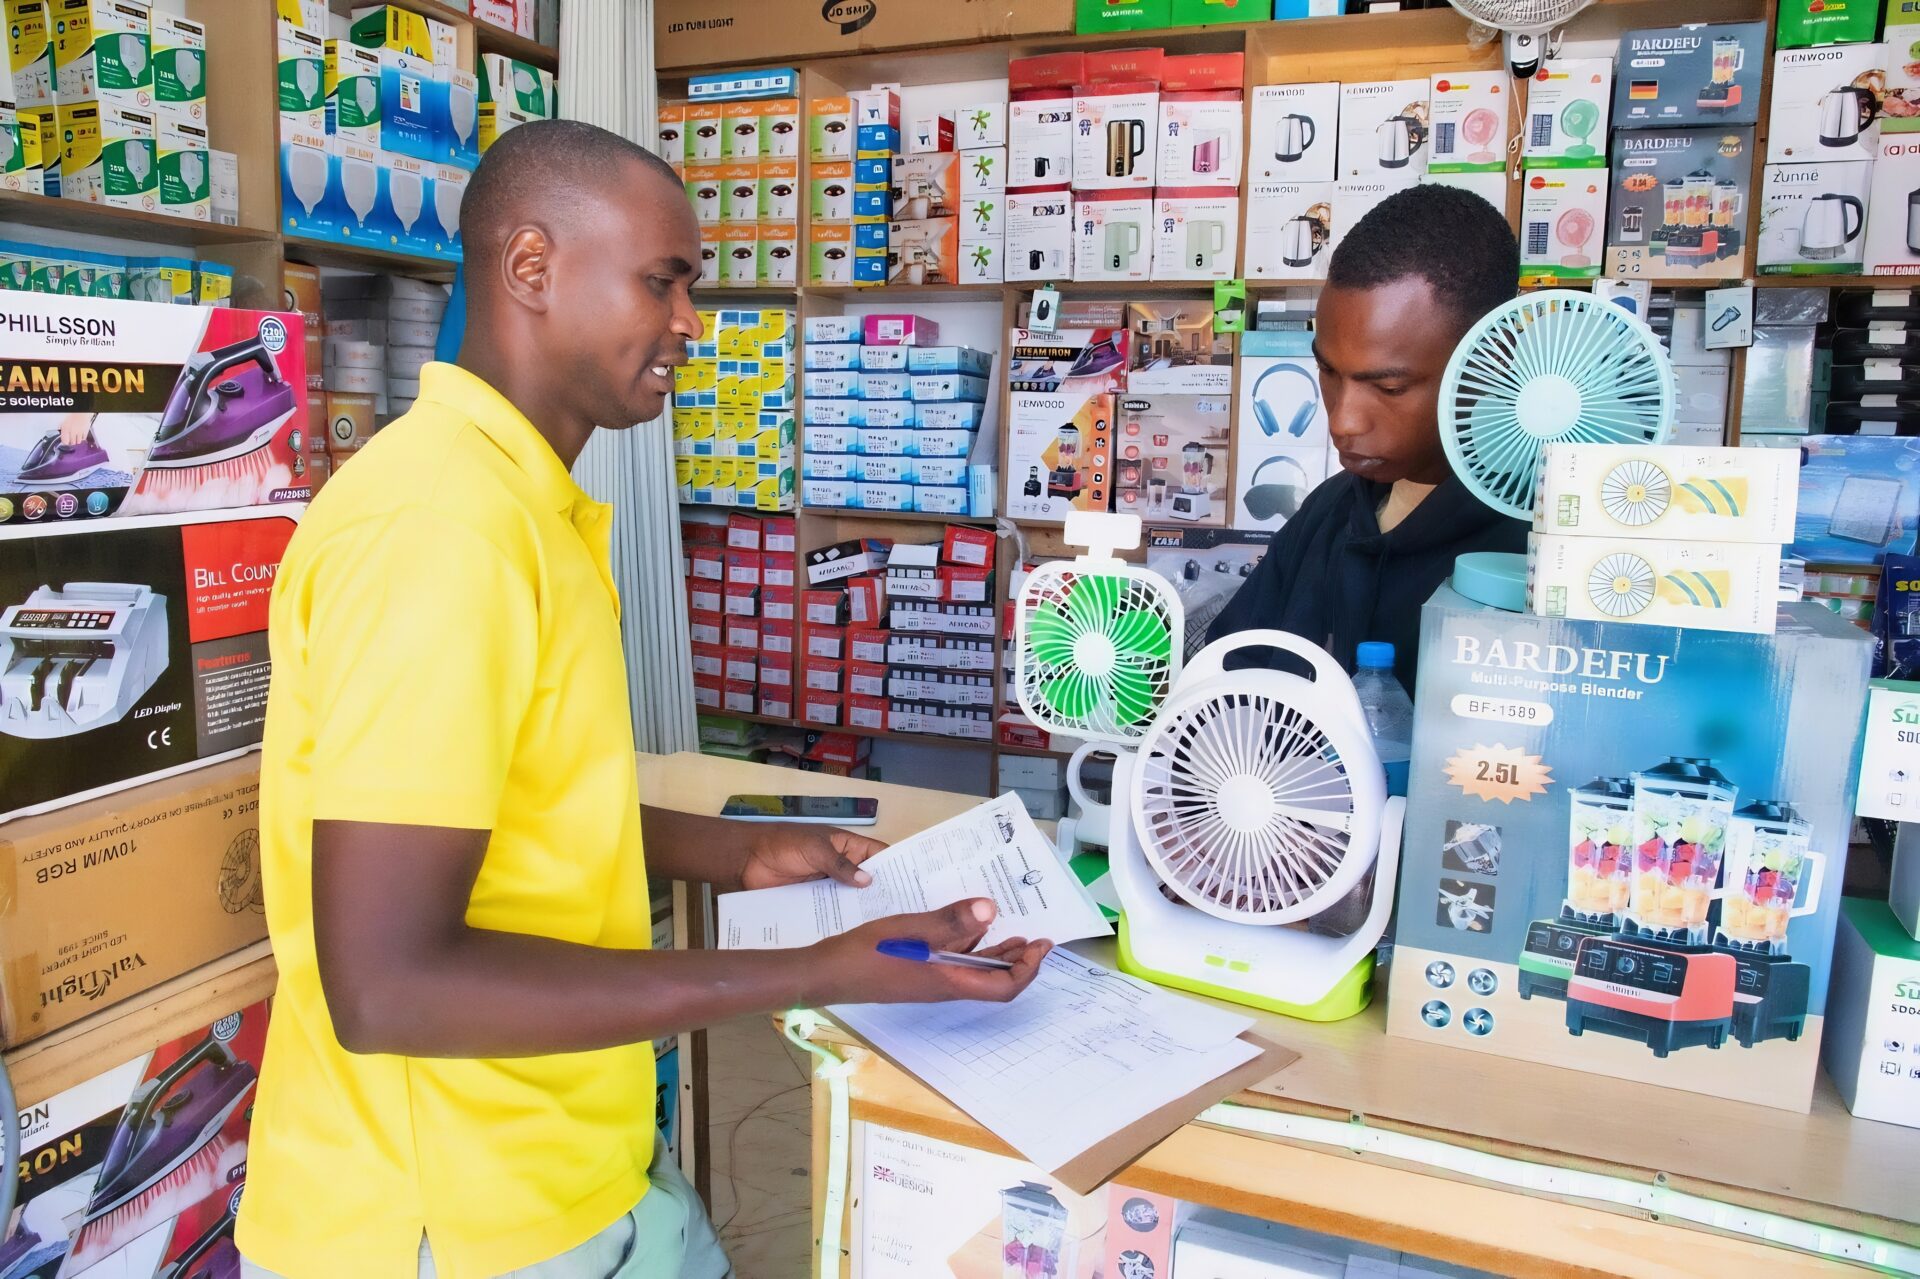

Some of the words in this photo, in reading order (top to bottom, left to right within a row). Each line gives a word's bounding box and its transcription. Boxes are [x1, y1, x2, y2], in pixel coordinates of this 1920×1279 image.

[1632, 37, 1702, 50] BARDEFU
[1783, 52, 1843, 62] KENWOOD
[1624, 137, 1692, 150] BARDEFU
[45, 335, 77, 347] Simply
[69, 366, 145, 393] IRON
[10, 395, 74, 408] soleplate
[1018, 400, 1065, 409] KENWOOD
[1451, 635, 1670, 684] BARDEFU
[1471, 671, 1577, 695] Multi-Purpose
[1581, 683, 1644, 701] Blender
[134, 708, 153, 719] LED
[154, 702, 182, 715] Display
[1469, 701, 1536, 719] BF-1589
[1476, 760, 1519, 785] 2.5L
[88, 822, 129, 844] QUALITY
[65, 838, 85, 850] AND
[22, 844, 62, 864] SAFETY
[83, 839, 138, 869] 10W/M
[36, 858, 77, 884] RGB
[84, 930, 108, 946] SINCE
[111, 934, 128, 946] LED
[41, 955, 79, 976] EXPERT
